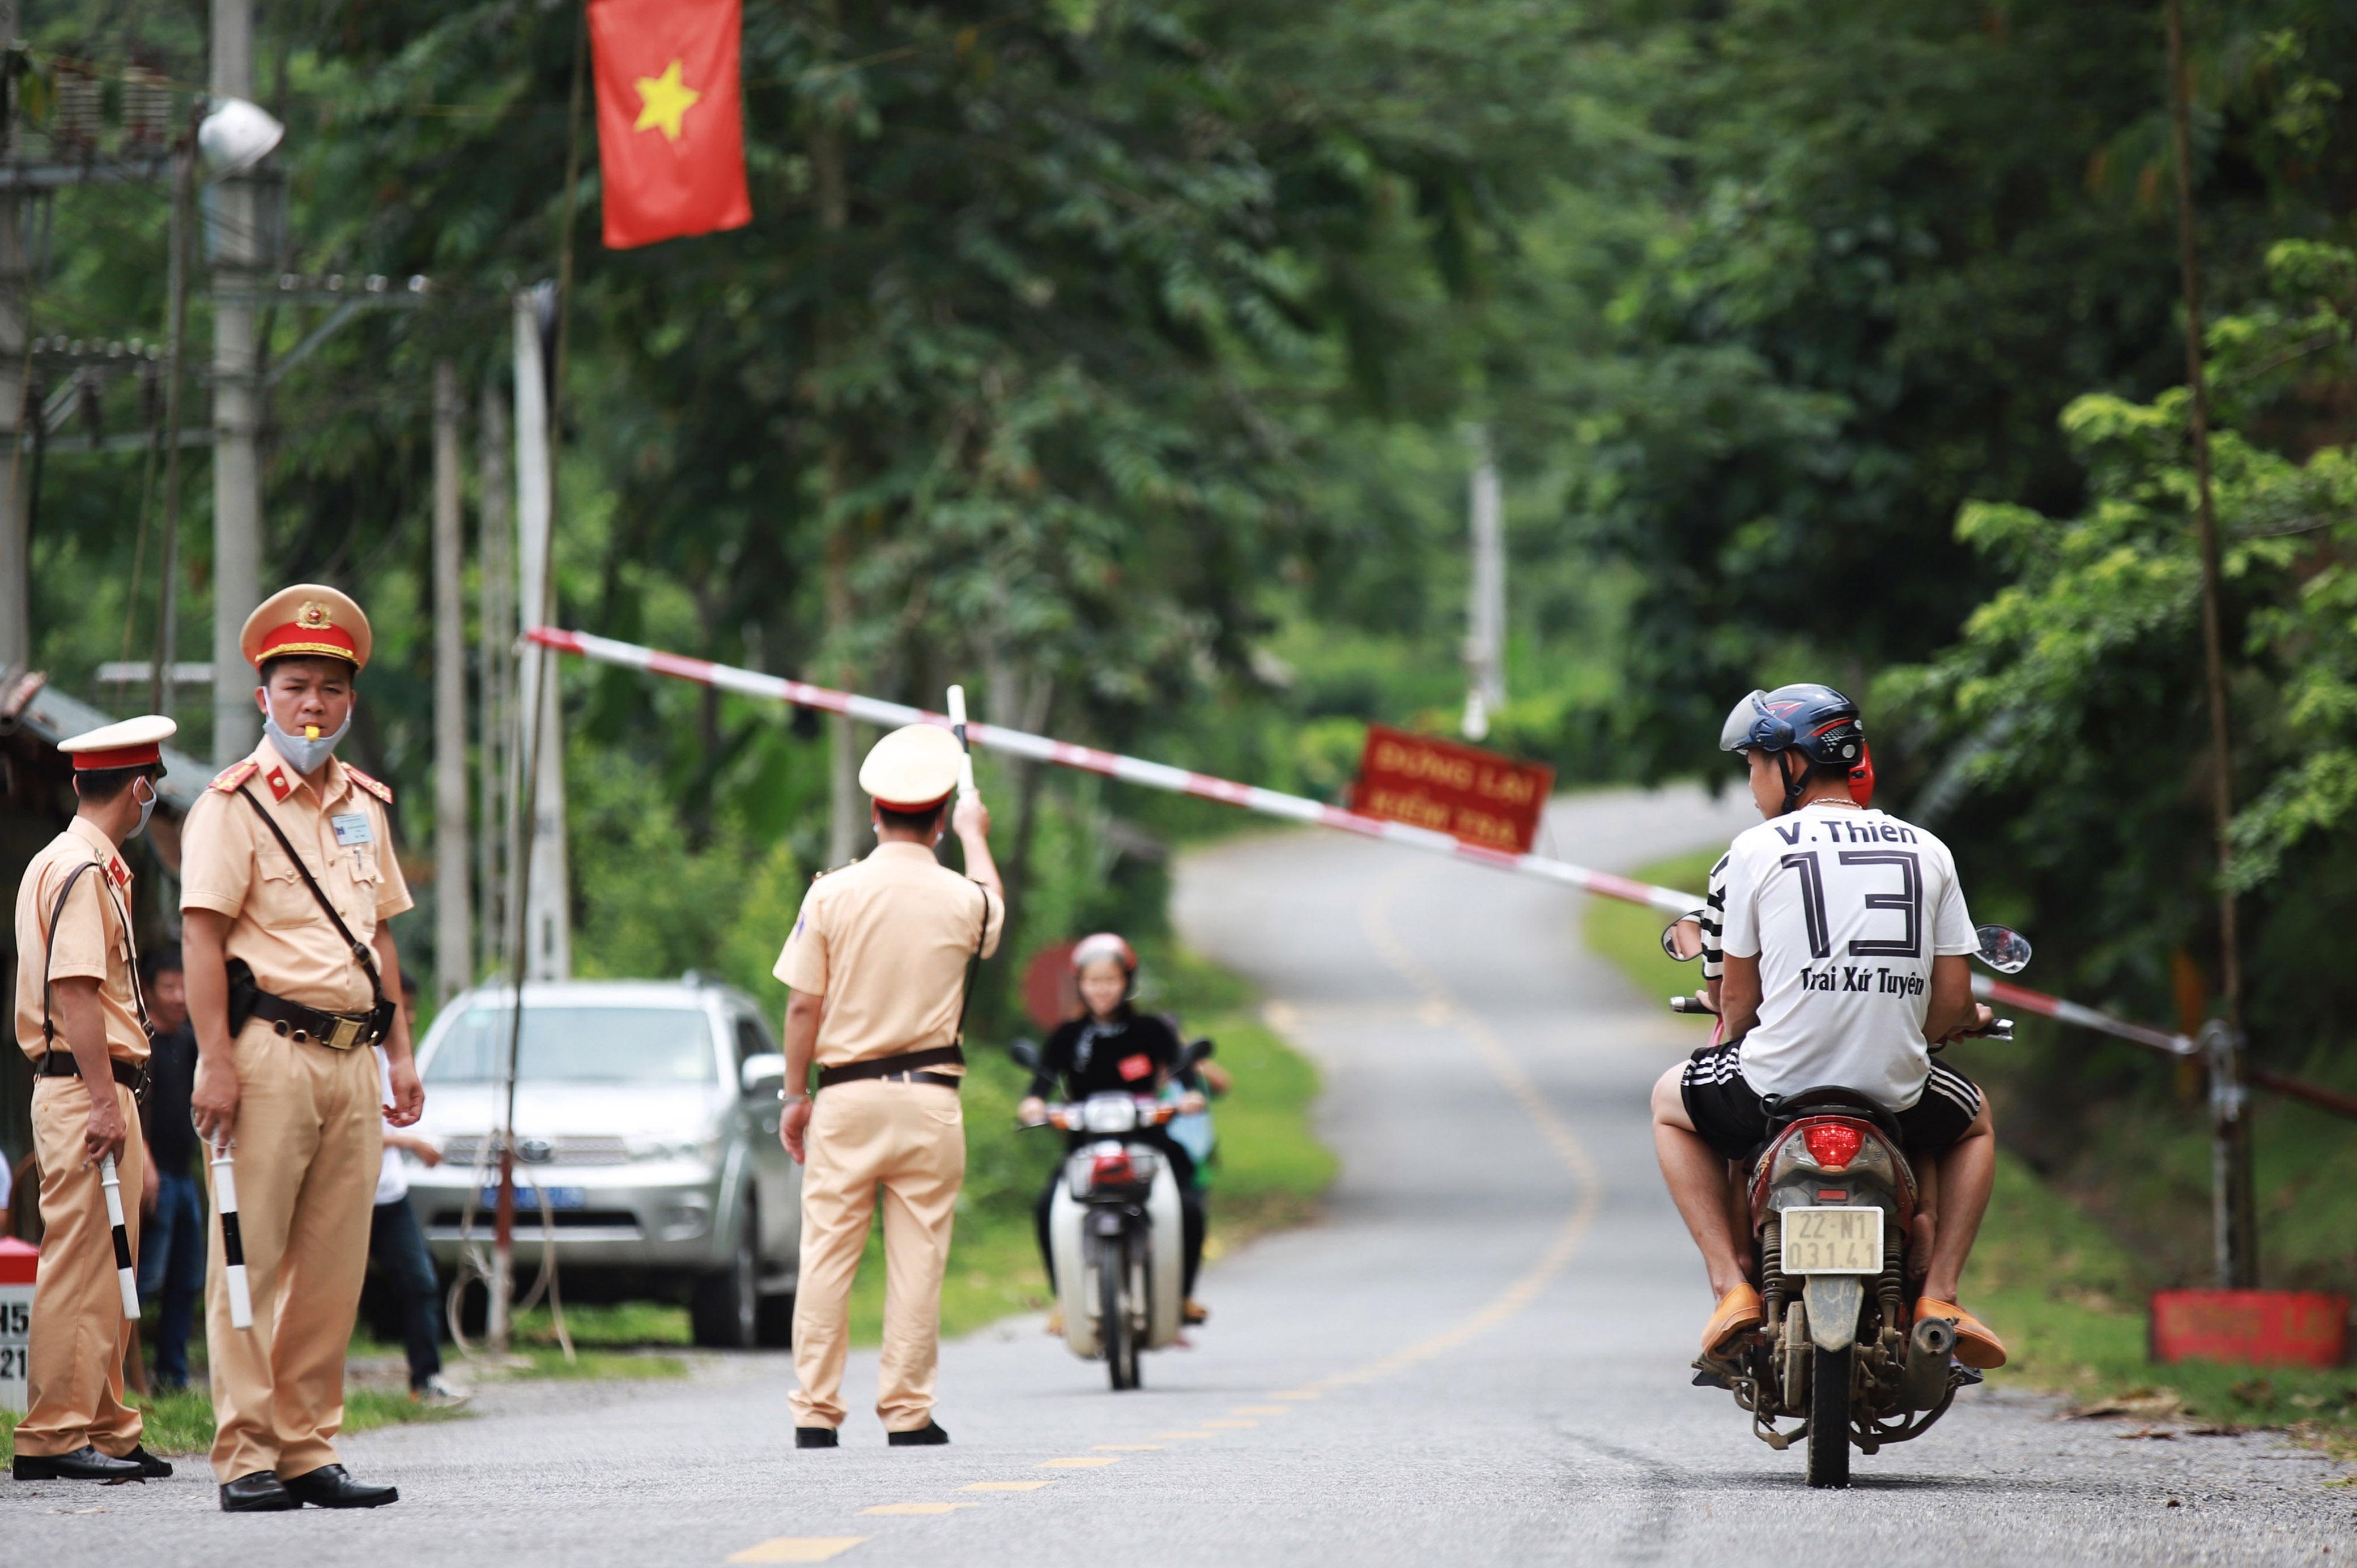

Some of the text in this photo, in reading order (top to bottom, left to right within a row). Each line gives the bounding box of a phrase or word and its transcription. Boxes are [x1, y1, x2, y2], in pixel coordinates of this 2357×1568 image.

[1781, 851, 1922, 958] 13
[1800, 966, 1924, 998] Trai Xứ Tuyên
